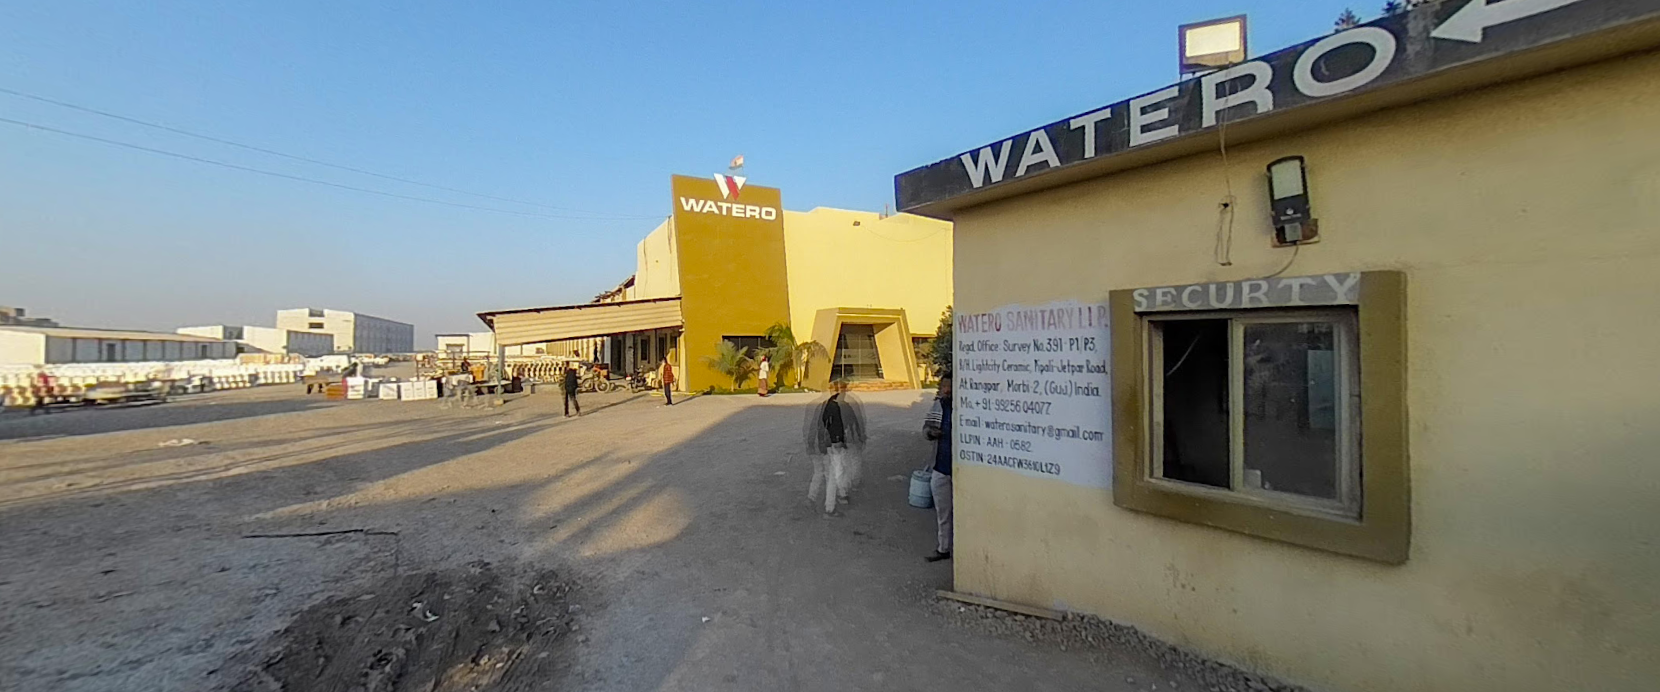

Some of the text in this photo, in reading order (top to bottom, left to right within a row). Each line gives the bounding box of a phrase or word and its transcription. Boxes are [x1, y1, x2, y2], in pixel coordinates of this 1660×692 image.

[959, 26, 1397, 189] WATERO
[680, 196, 777, 220] WATERO
[1132, 272, 1361, 312] SECURTY
[958, 312, 1002, 333] WATERO
[1006, 307, 1074, 332] SANITARY
[1003, 339, 1031, 354] Survey
